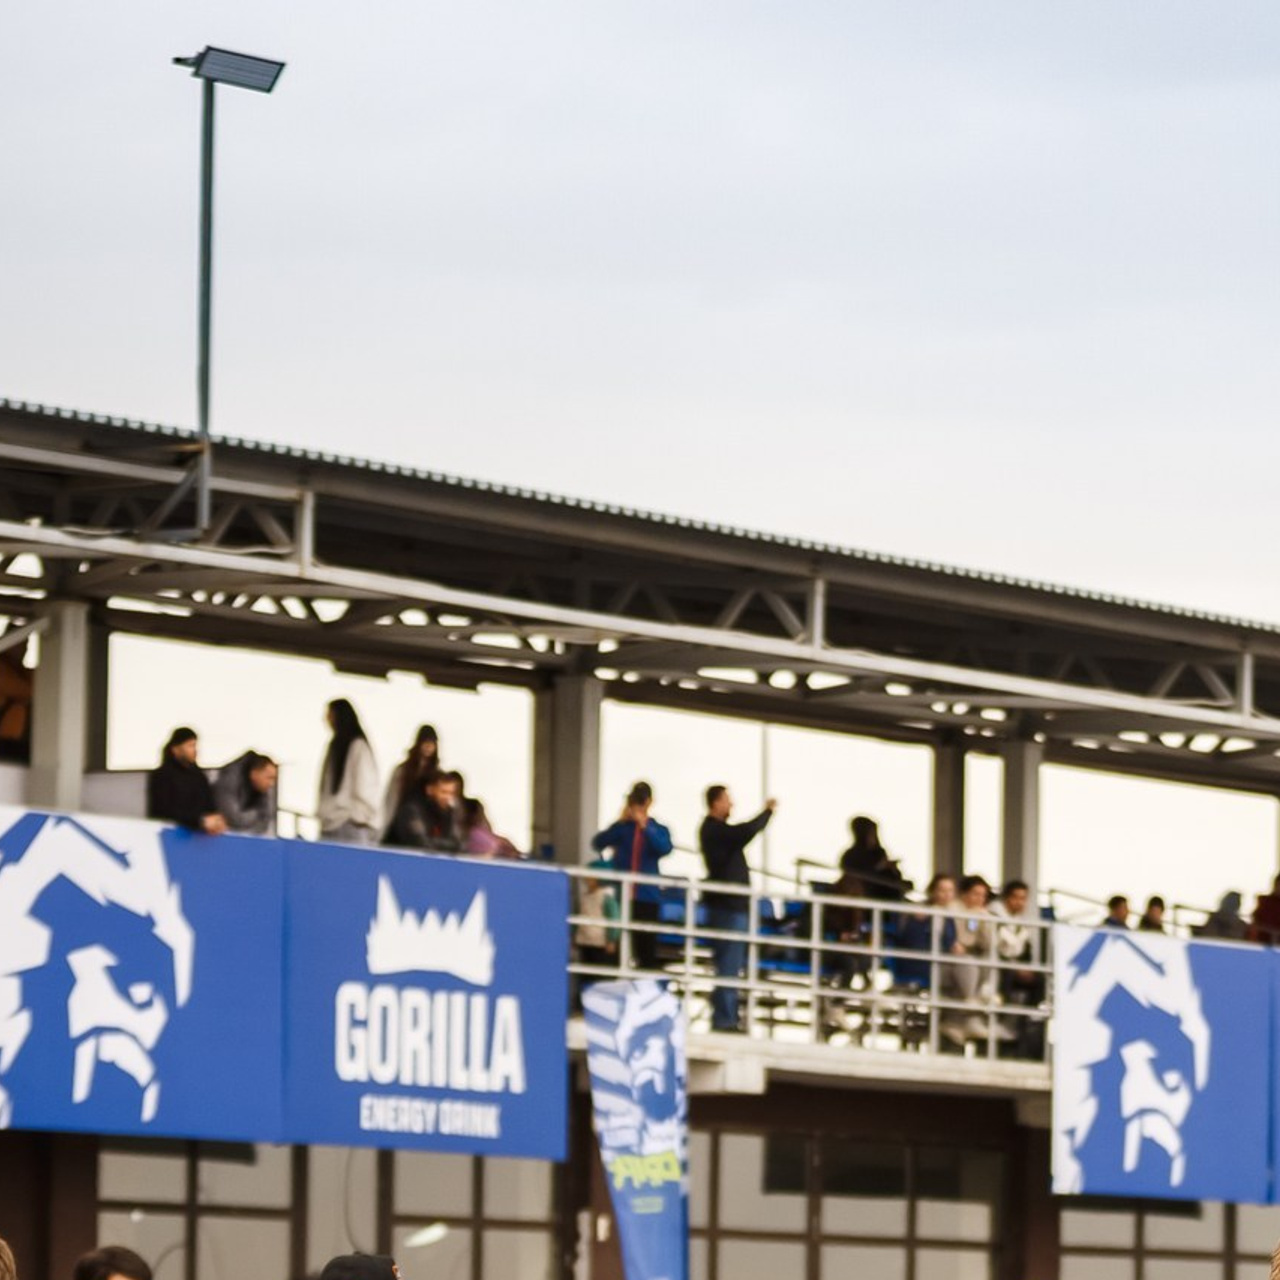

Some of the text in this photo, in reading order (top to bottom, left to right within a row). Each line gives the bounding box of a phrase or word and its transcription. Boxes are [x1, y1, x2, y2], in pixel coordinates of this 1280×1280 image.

[334, 980, 526, 1094] GORILLA
[359, 1093, 501, 1139] ENERGY DRINK
